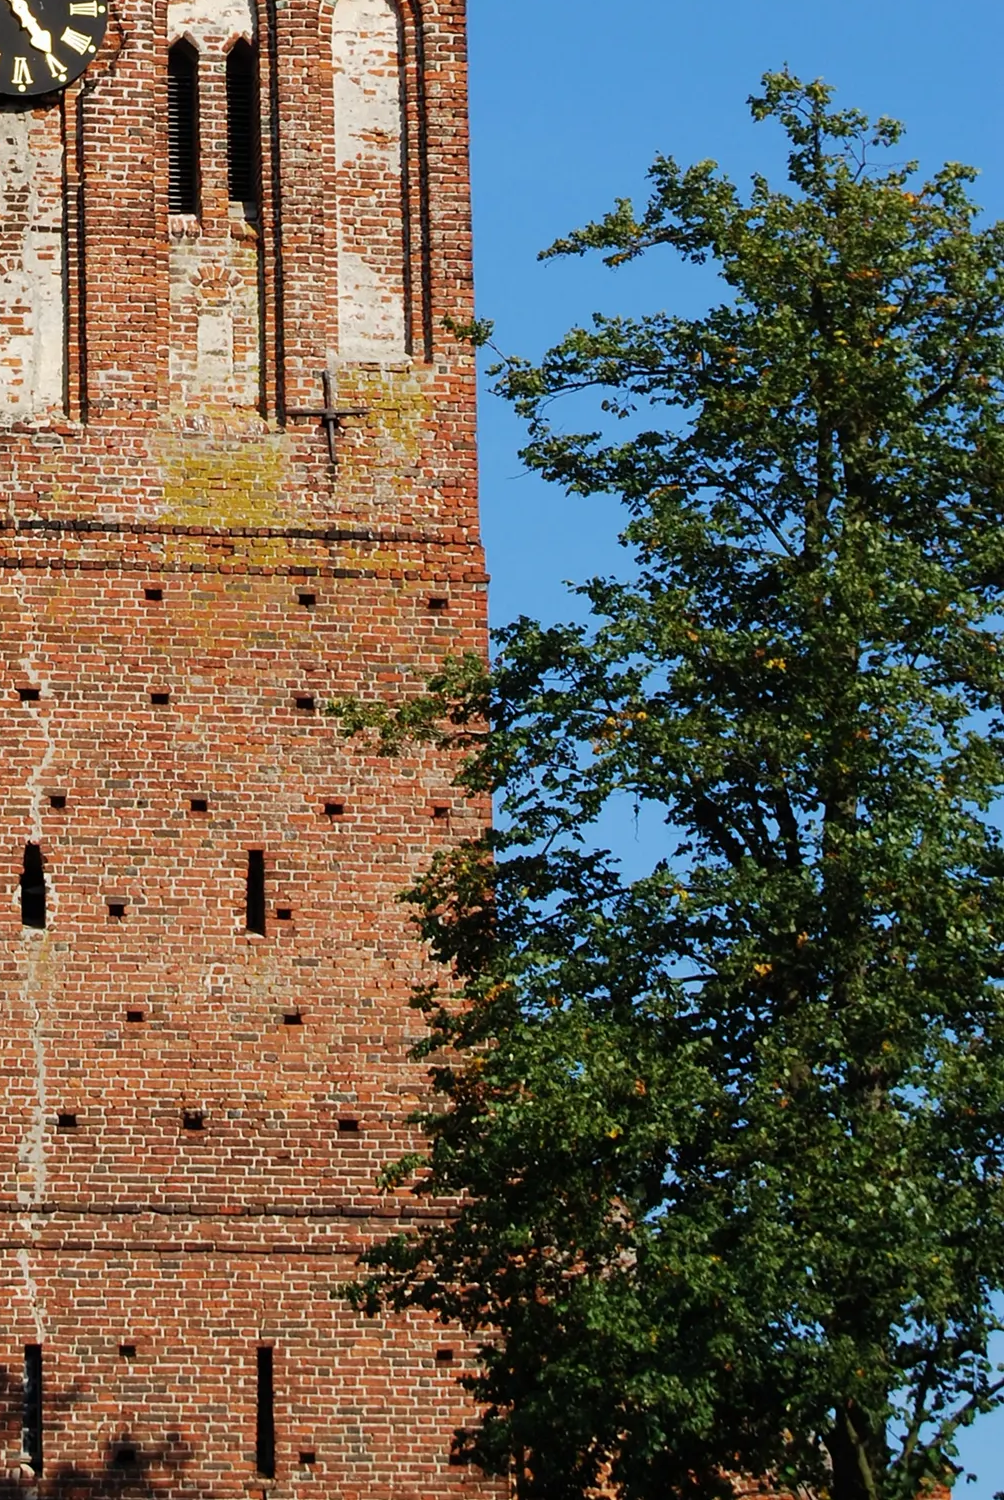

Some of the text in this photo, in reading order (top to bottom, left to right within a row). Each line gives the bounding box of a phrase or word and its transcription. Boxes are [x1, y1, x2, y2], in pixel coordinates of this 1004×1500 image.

[70, 0, 98, 18] III
[12, 57, 33, 84] VI
[46, 53, 67, 78] V
